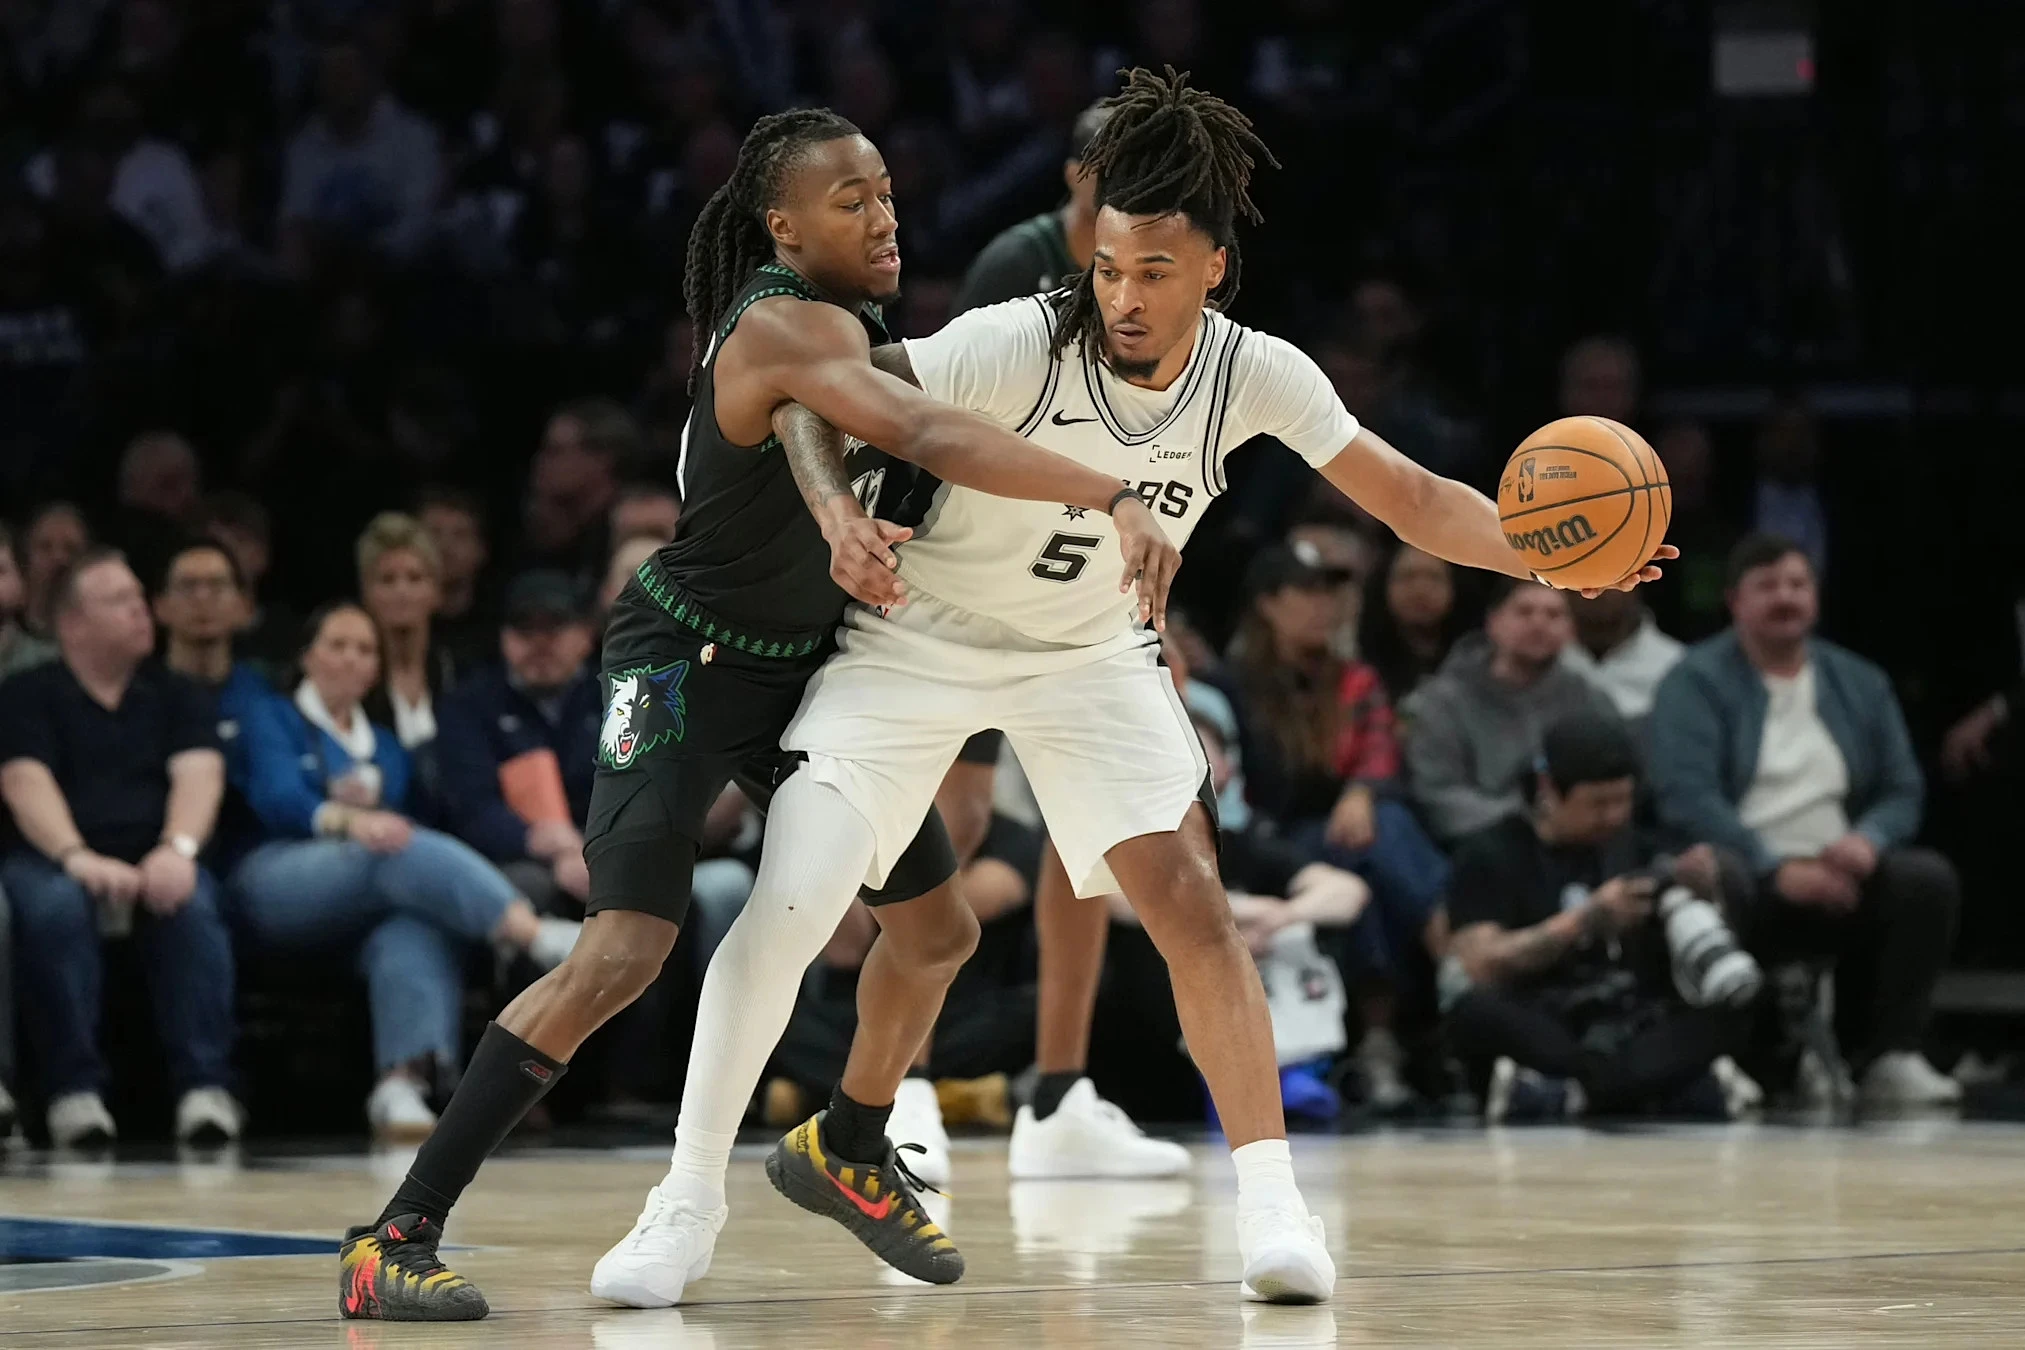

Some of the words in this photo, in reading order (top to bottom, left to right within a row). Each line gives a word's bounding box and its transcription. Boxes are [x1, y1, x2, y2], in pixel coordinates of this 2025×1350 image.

[1157, 450, 1193, 460] LEDGER
[1504, 514, 1597, 556] Wilson
[1028, 530, 1104, 584] 5
